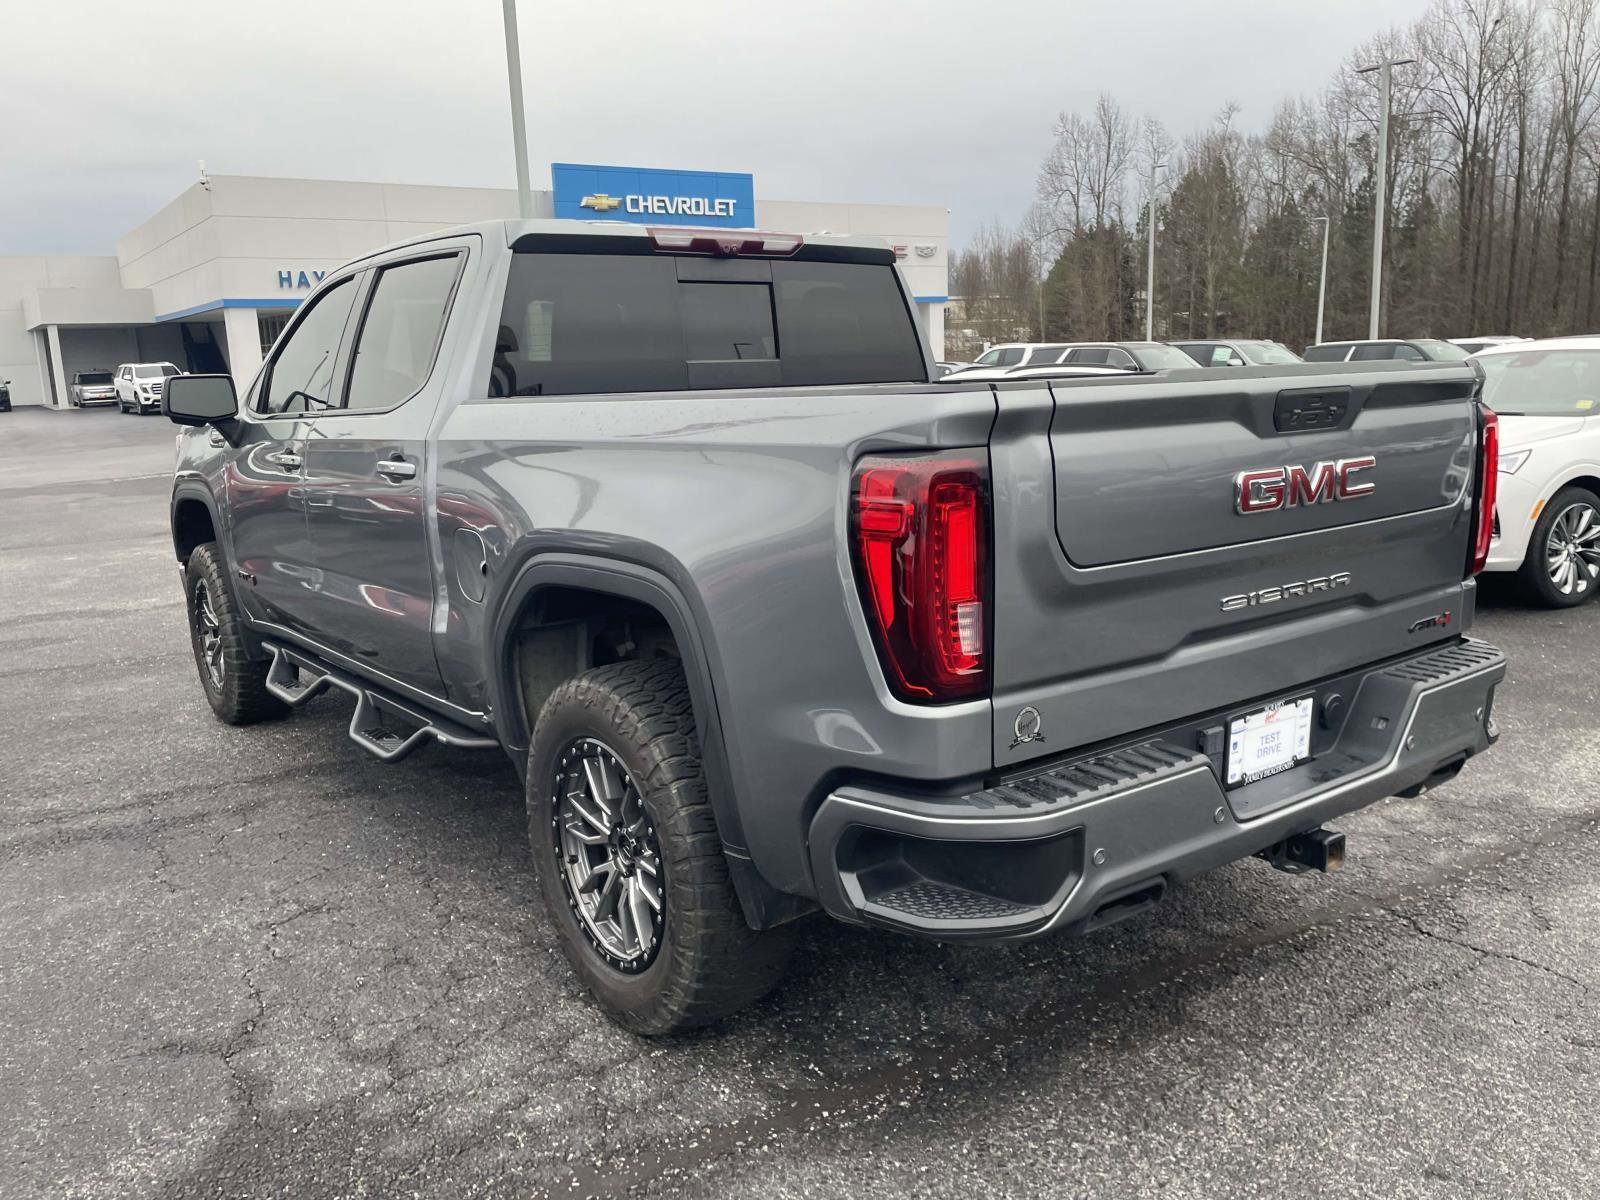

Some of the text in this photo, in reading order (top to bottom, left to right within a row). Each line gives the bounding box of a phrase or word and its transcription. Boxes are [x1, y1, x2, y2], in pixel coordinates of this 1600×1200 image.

[626, 195, 737, 217] CHEVROLET
[1233, 455, 1377, 515] GMC
[1220, 571, 1351, 612] SIERRA
[1408, 610, 1451, 633] AT4
[1260, 731, 1281, 746] TEST
[1257, 743, 1282, 759] DRIVE
